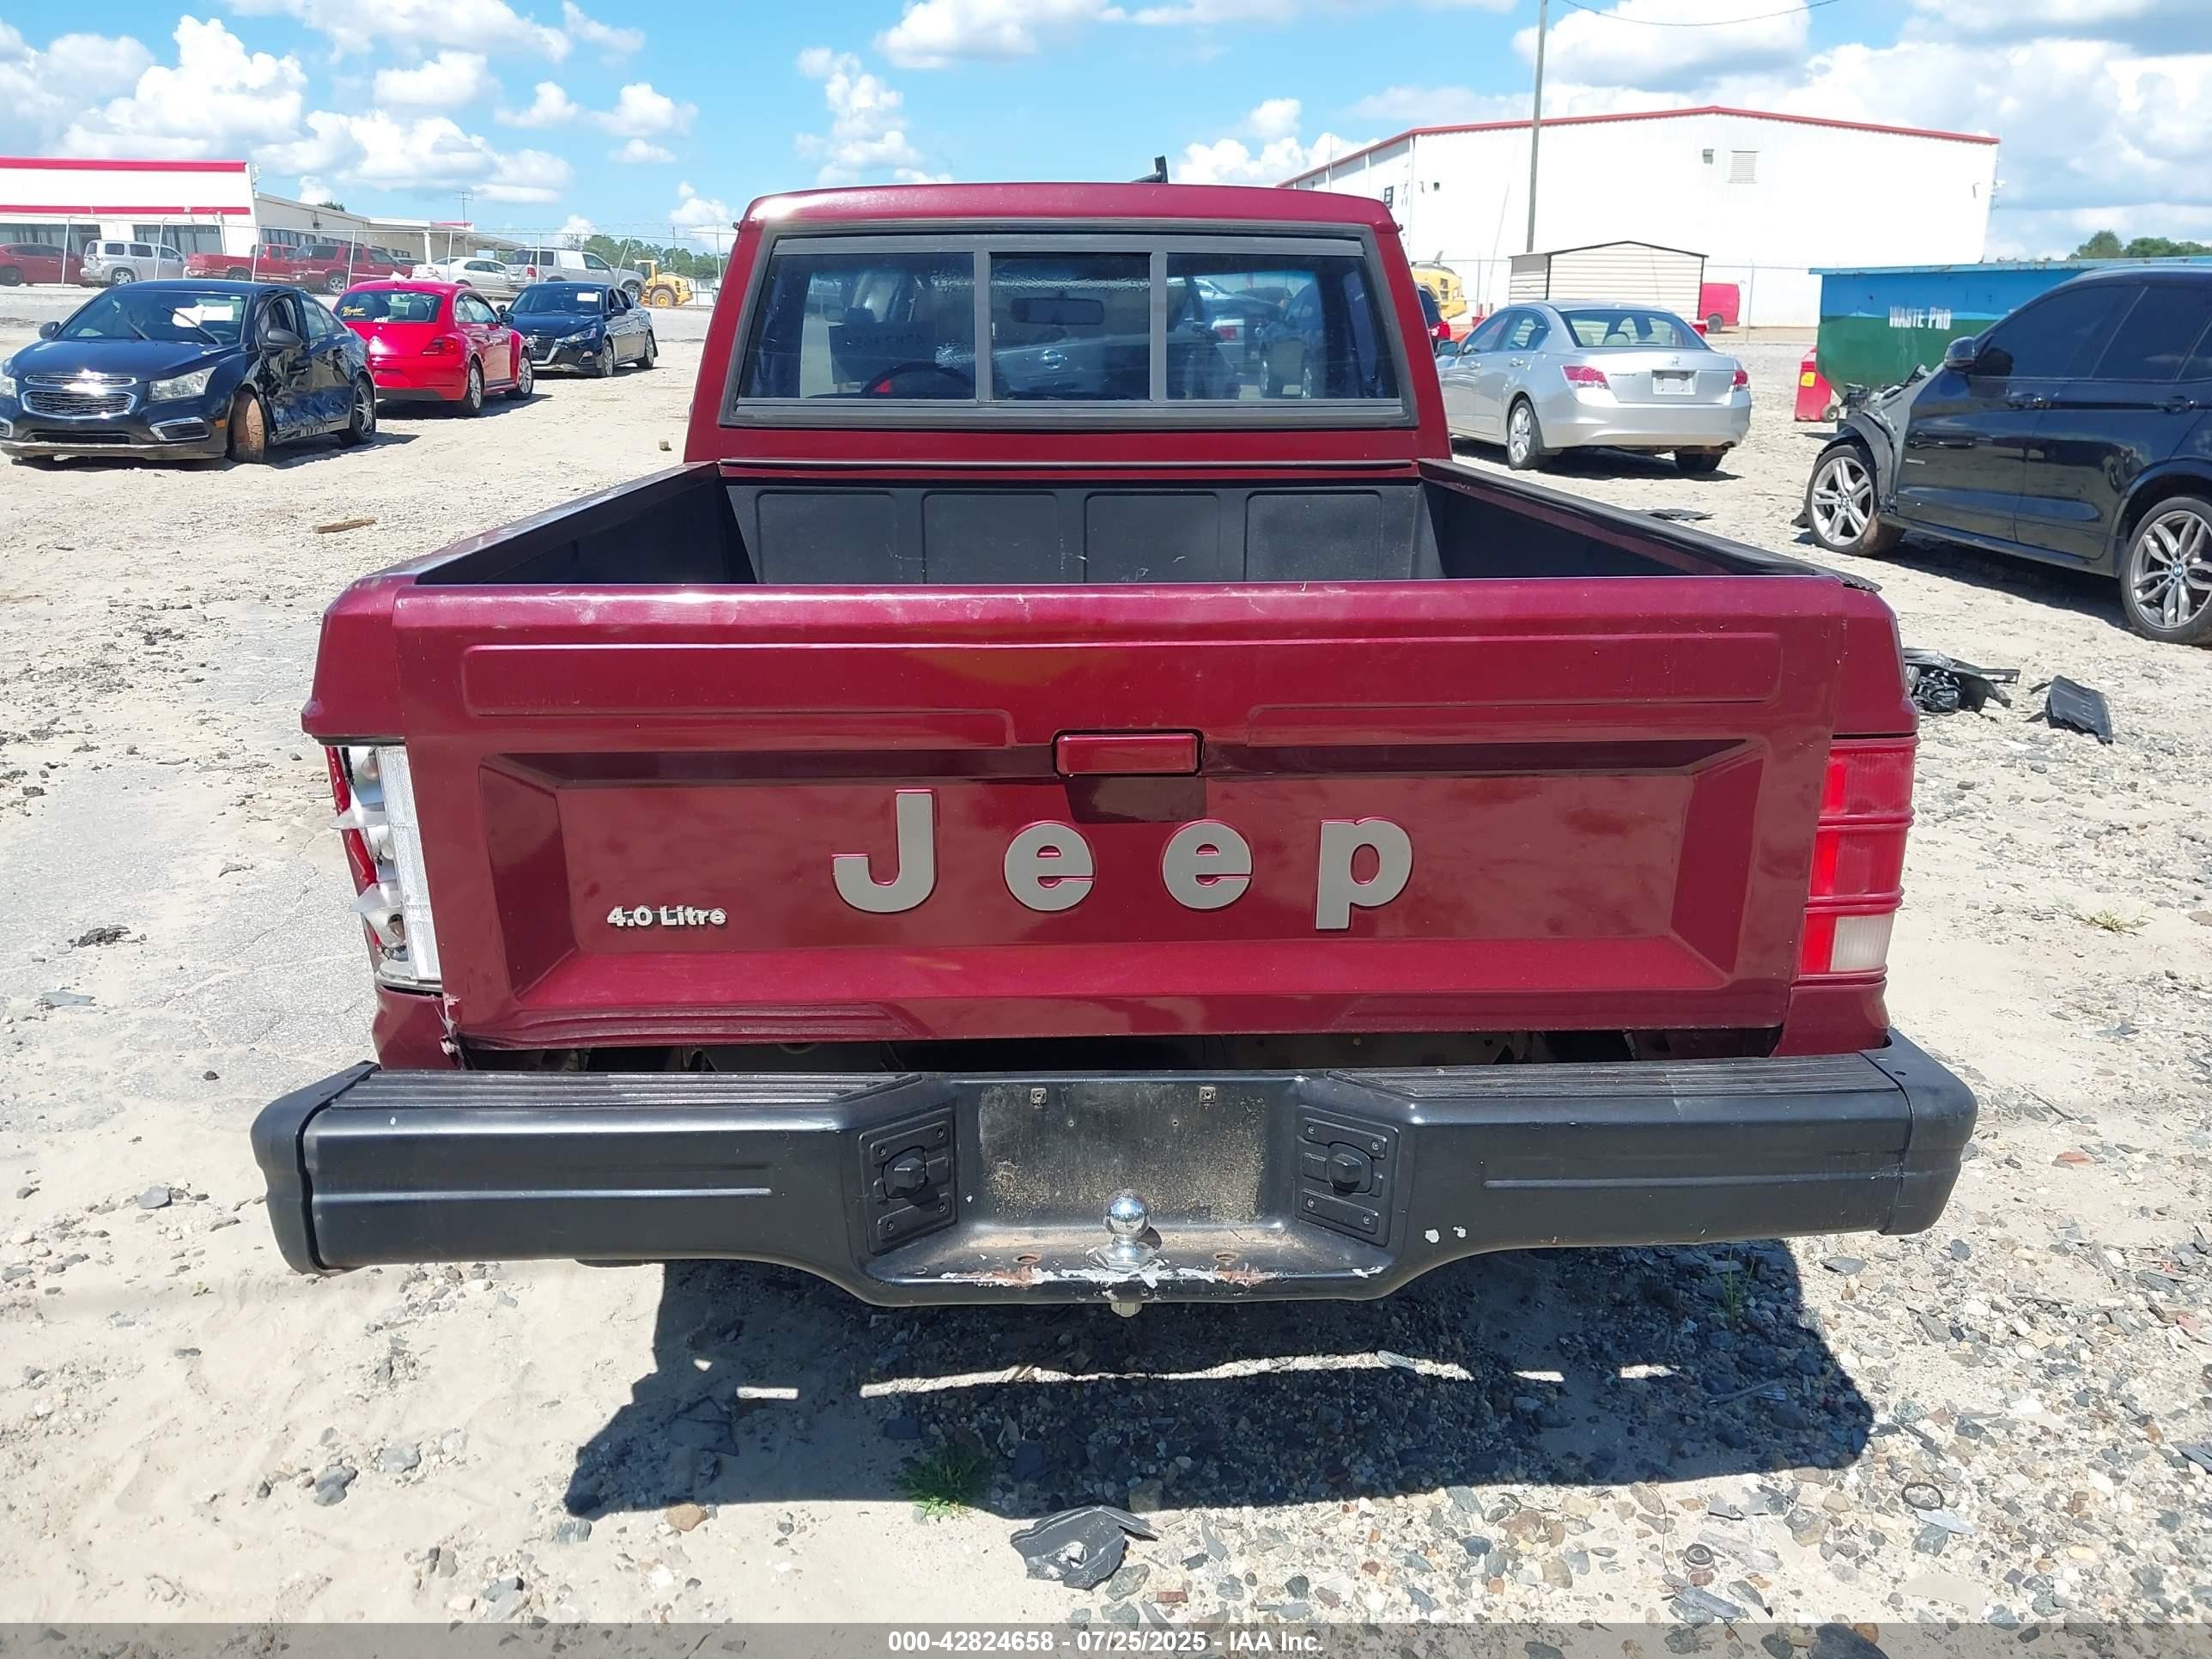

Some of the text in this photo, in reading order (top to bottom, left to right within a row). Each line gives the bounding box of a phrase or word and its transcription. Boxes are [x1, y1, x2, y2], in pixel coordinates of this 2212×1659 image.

[1889, 306, 1923, 328] WASTE
[831, 789, 1413, 931] Jeep
[606, 905, 727, 927] 4.0 Litre
